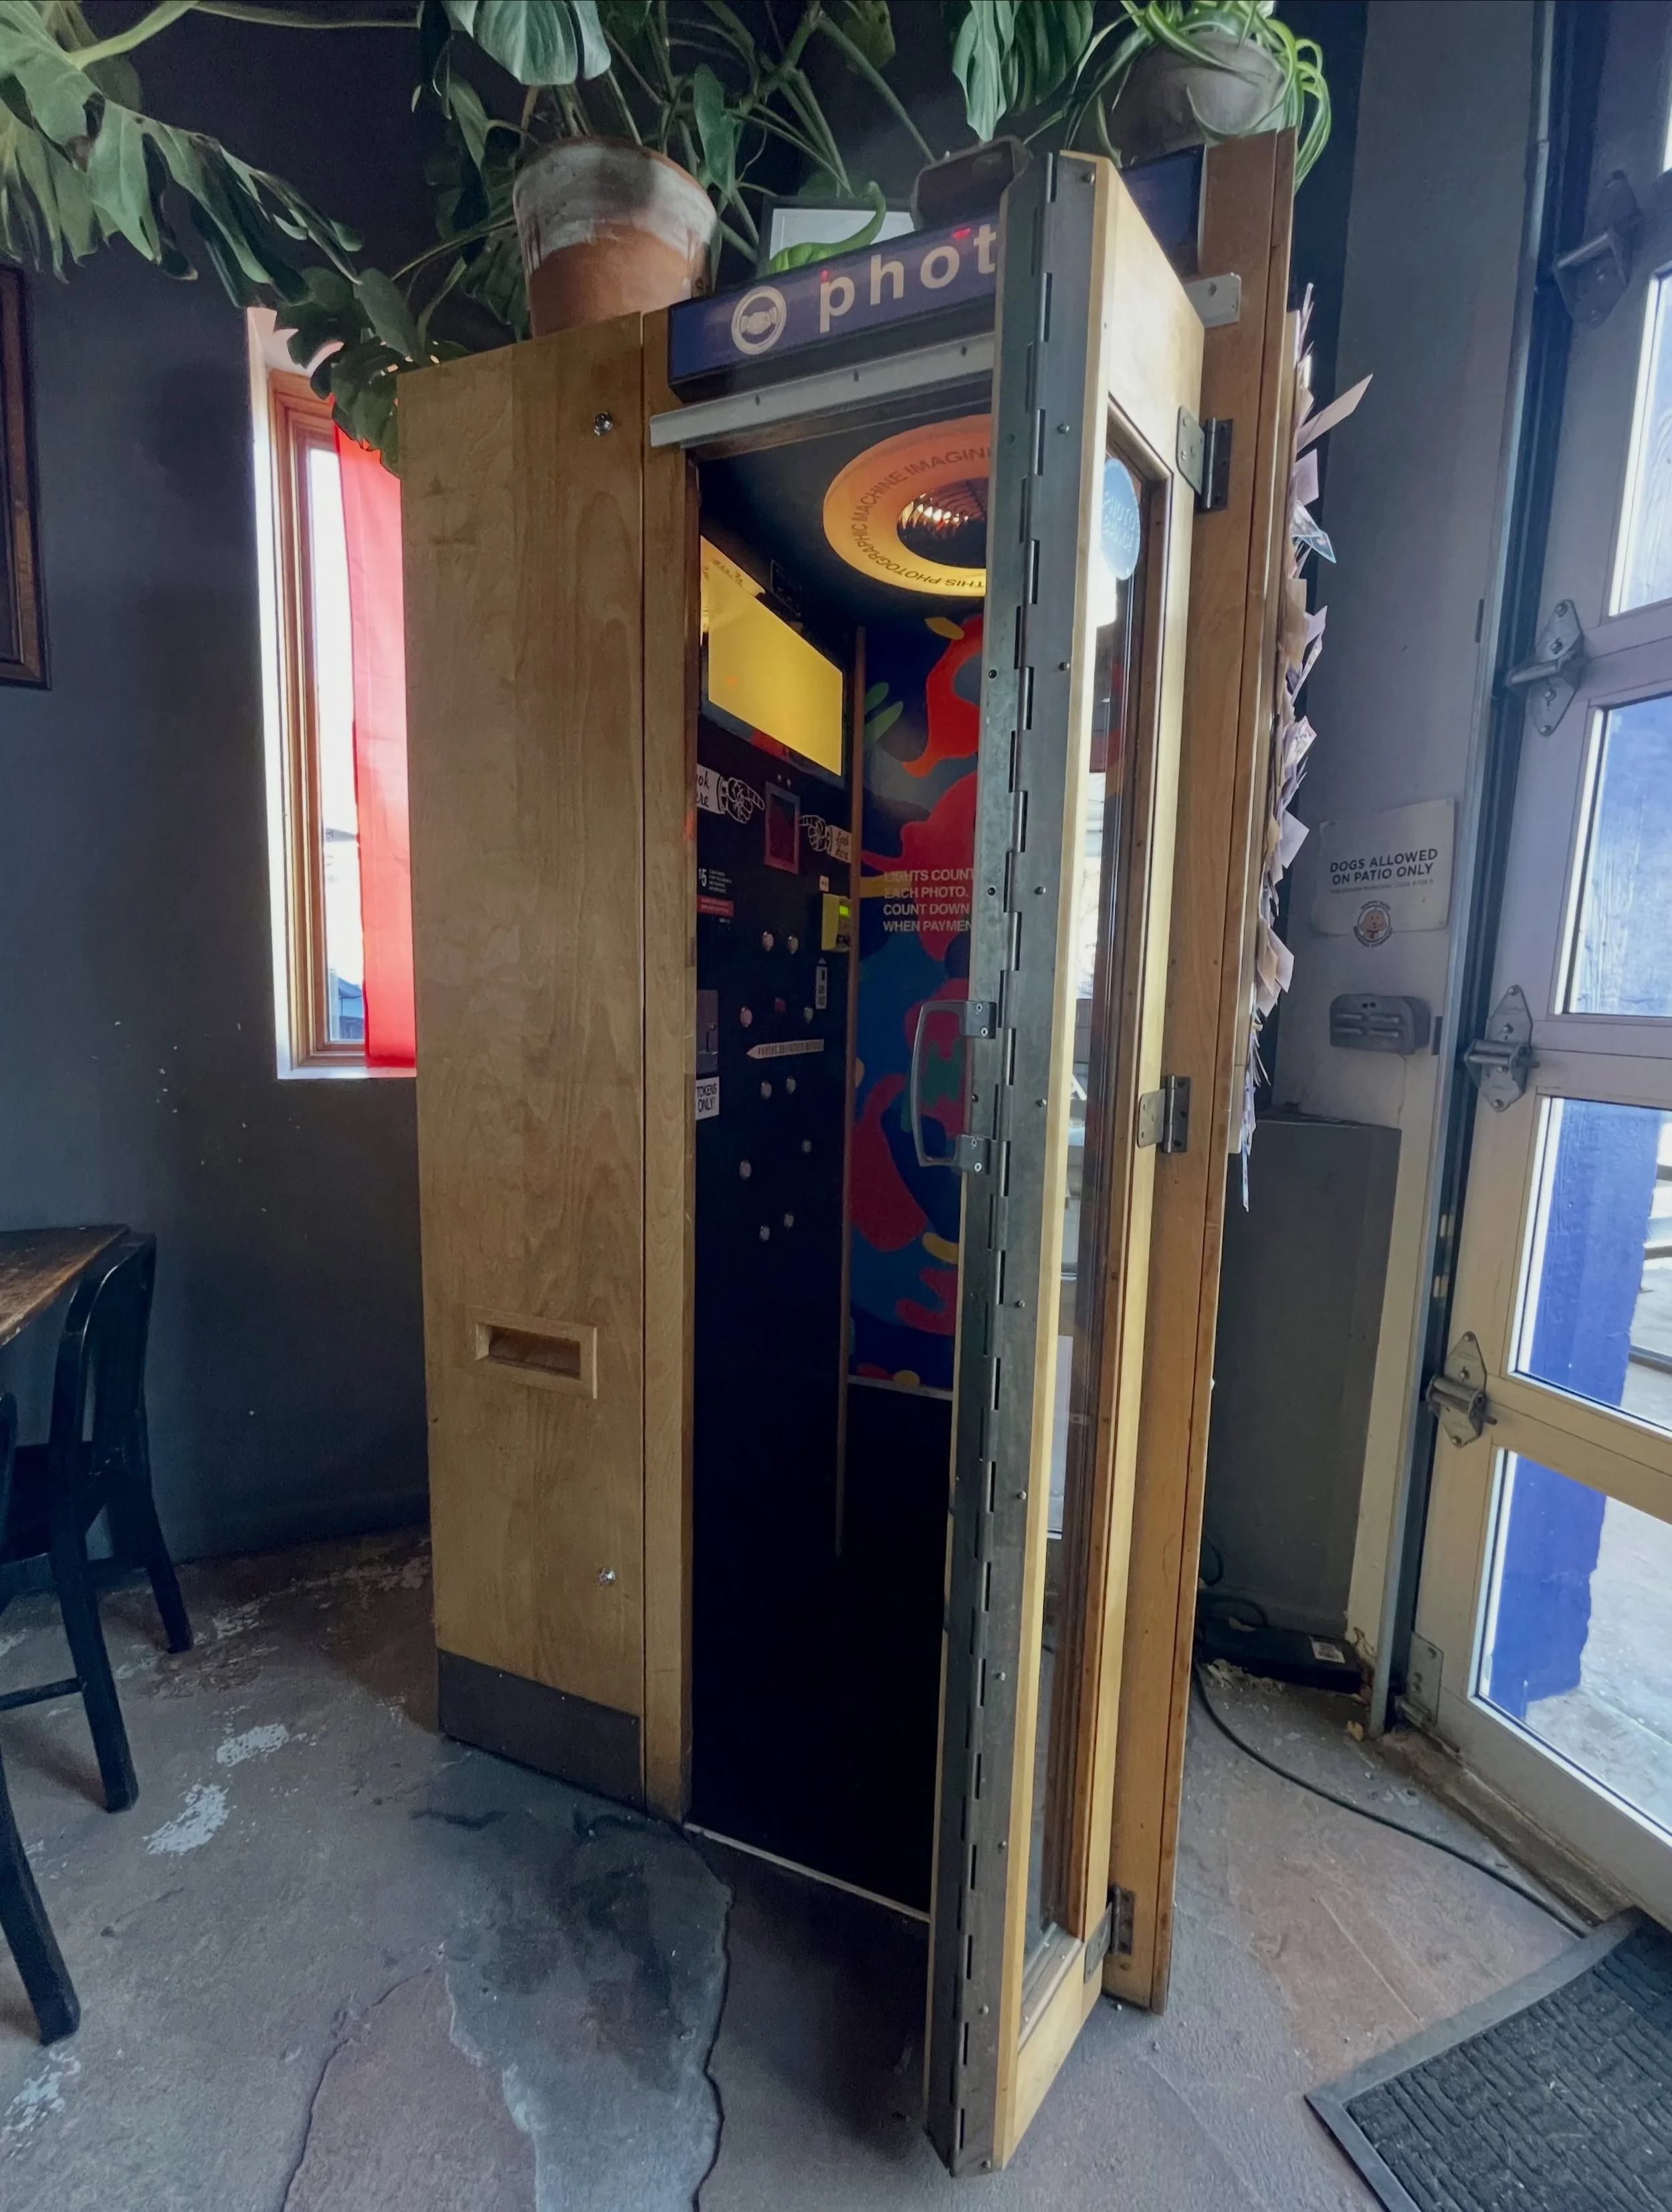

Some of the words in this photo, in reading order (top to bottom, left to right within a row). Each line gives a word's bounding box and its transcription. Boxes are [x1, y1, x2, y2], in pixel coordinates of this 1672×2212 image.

[819, 223, 996, 333] phot
[905, 446, 992, 476] IMAGIN
[851, 470, 907, 522] MACHINE
[851, 523, 942, 585] PHOTOGRAPHIC
[945, 579, 985, 588] THIS
[696, 770, 710, 789] ok
[1330, 858, 1365, 874] DOGS
[1369, 848, 1438, 868] ALLOWED
[884, 870, 928, 882] LIGHTS
[1332, 873, 1350, 885] ON
[1354, 868, 1392, 882] PATIO
[1396, 863, 1434, 877] ONLY
[884, 887, 918, 899] EACH
[921, 886, 968, 898] PHOTO.
[883, 904, 928, 916] COUNT
[930, 903, 970, 915] DOWN
[883, 920, 920, 932] WHEN
